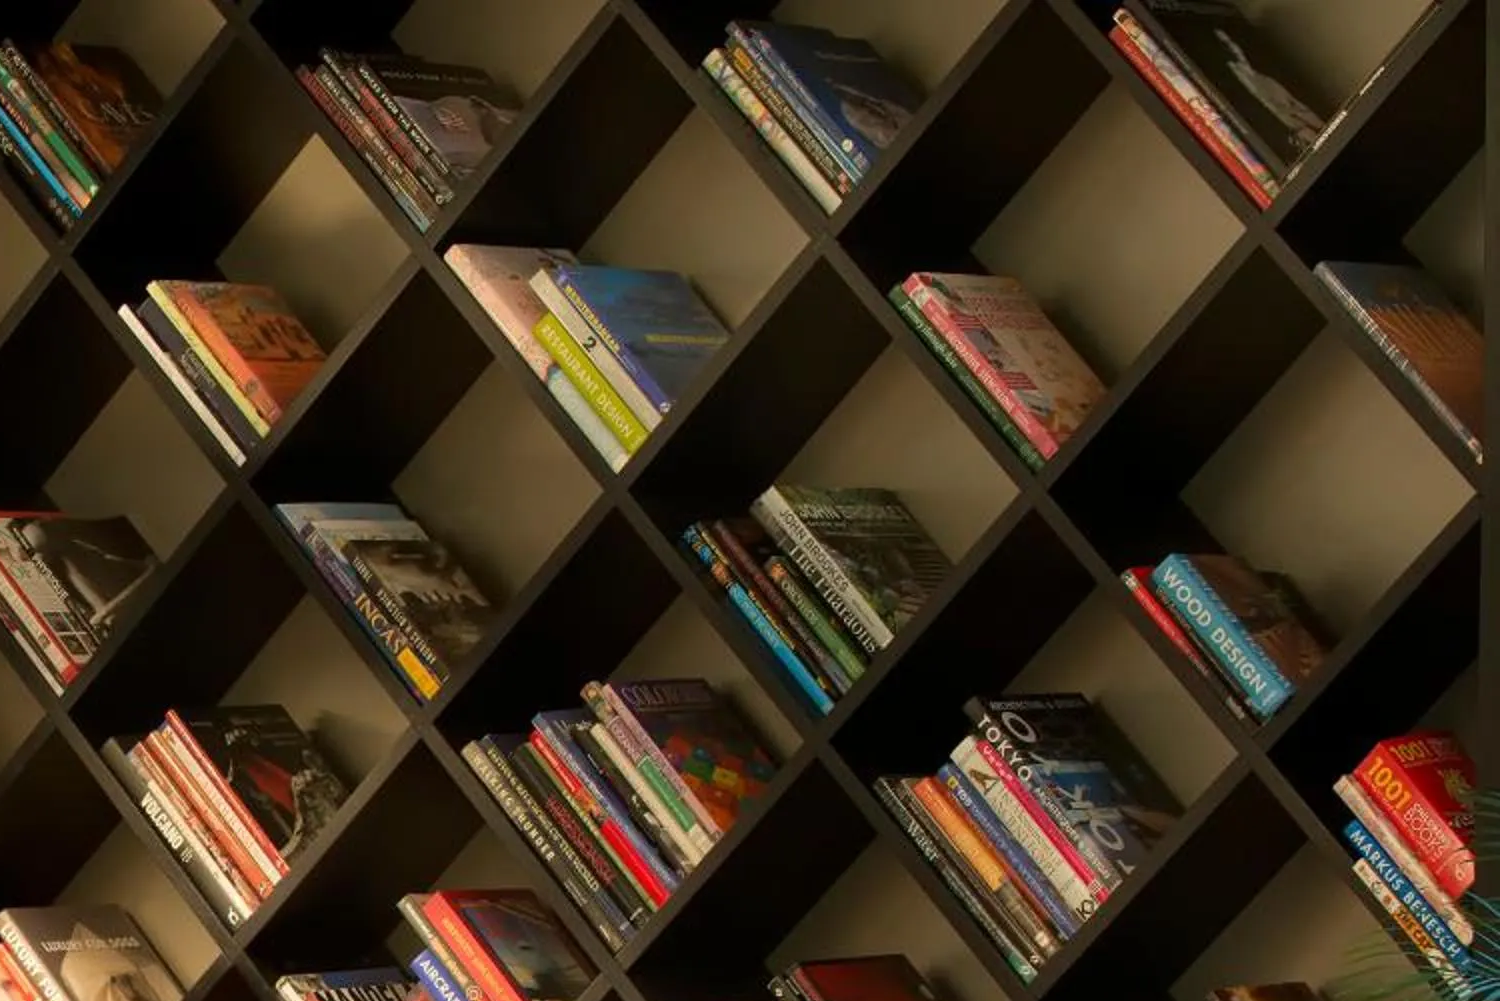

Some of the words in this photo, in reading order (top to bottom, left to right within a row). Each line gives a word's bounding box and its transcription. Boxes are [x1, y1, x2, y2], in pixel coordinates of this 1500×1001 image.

[580, 334, 598, 352] 2
[539, 323, 600, 395] RESTAURANT
[595, 393, 635, 439] DESIGN
[777, 507, 808, 541] JOHN
[801, 537, 851, 593] BROOKES
[350, 588, 410, 655] INCAS
[1156, 566, 1215, 630] WOOD
[1205, 626, 1270, 695] DESIGN
[972, 712, 1037, 784] TOKYO
[1362, 754, 1415, 813] 1001
[136, 790, 186, 851] VOLCANO
[903, 818, 942, 862] Water
[1400, 804, 1448, 860] BOOKS
[1348, 825, 1408, 891] MARKUS
[1400, 887, 1466, 958] BENESCH
[0, 921, 42, 979] LUXURY
